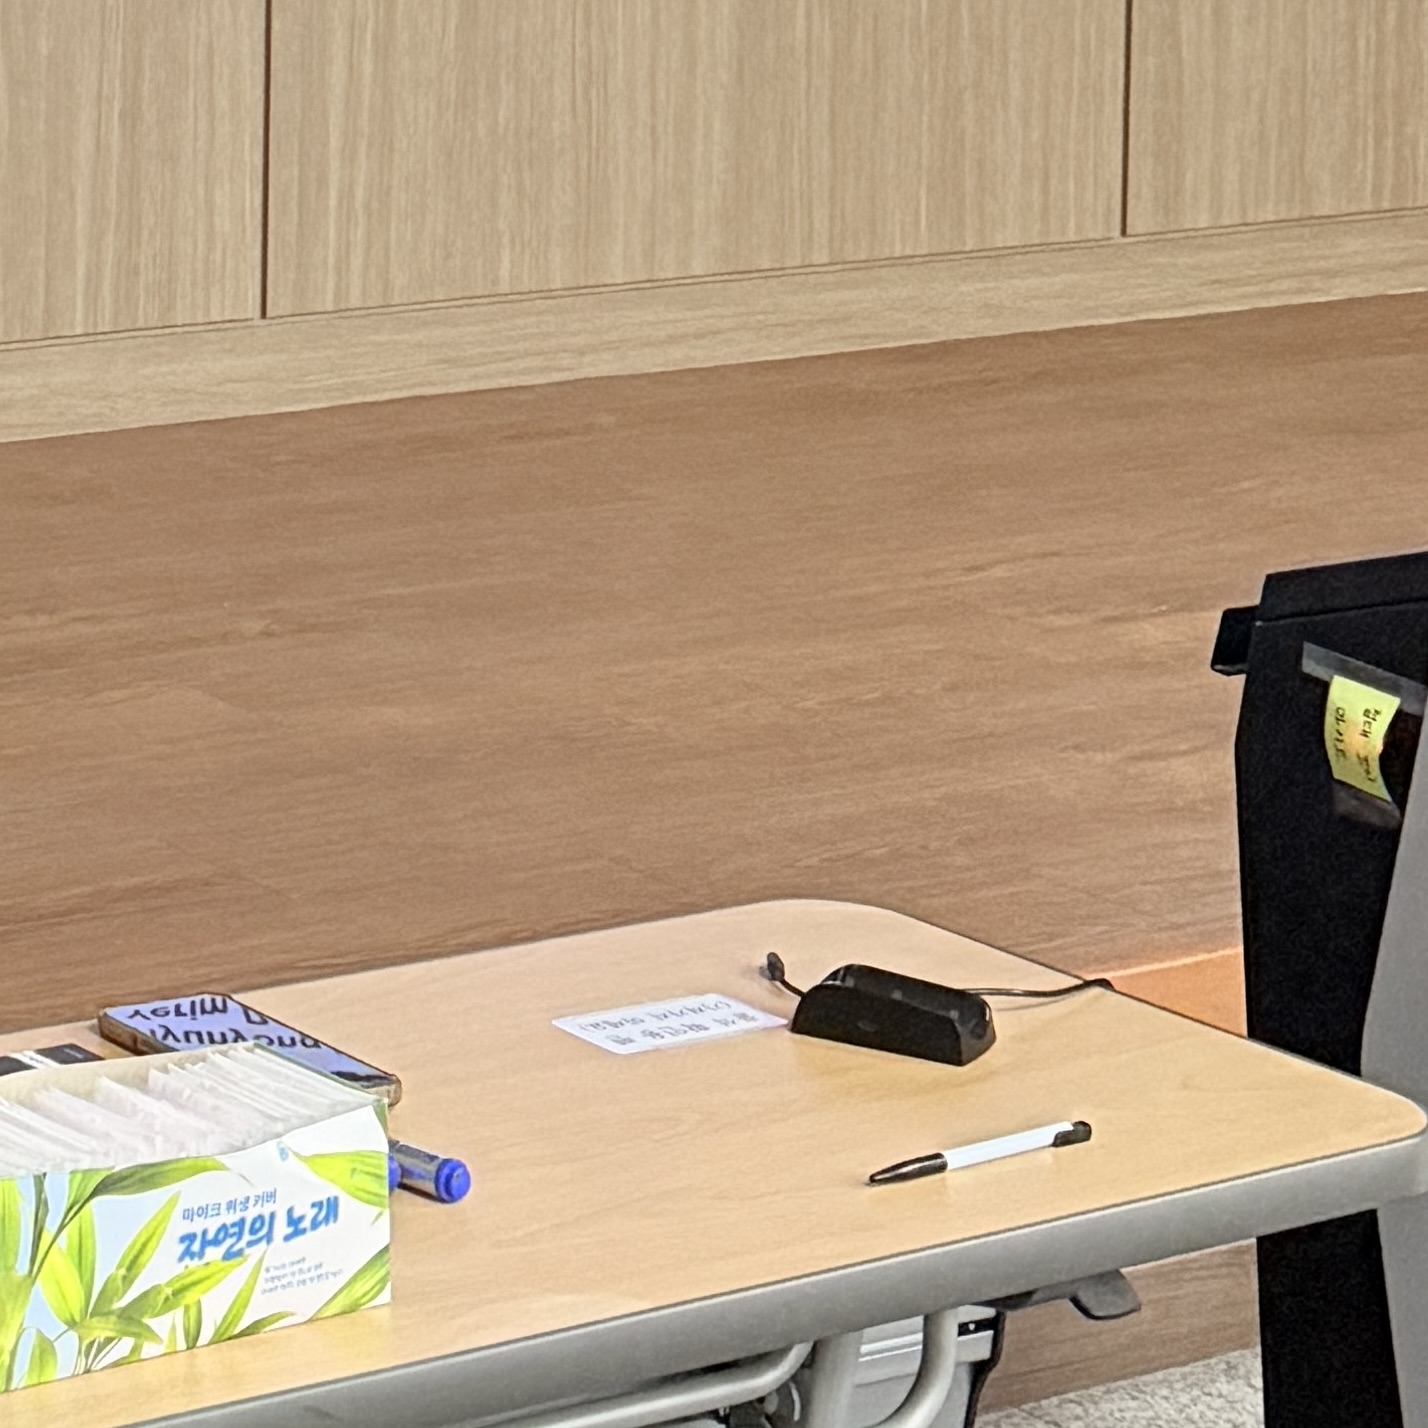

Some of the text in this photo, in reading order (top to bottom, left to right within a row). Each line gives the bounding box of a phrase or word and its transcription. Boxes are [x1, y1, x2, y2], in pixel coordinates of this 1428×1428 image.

[177, 1195, 340, 1264] 자연의 노래
[182, 1201, 223, 1223] 마이크
